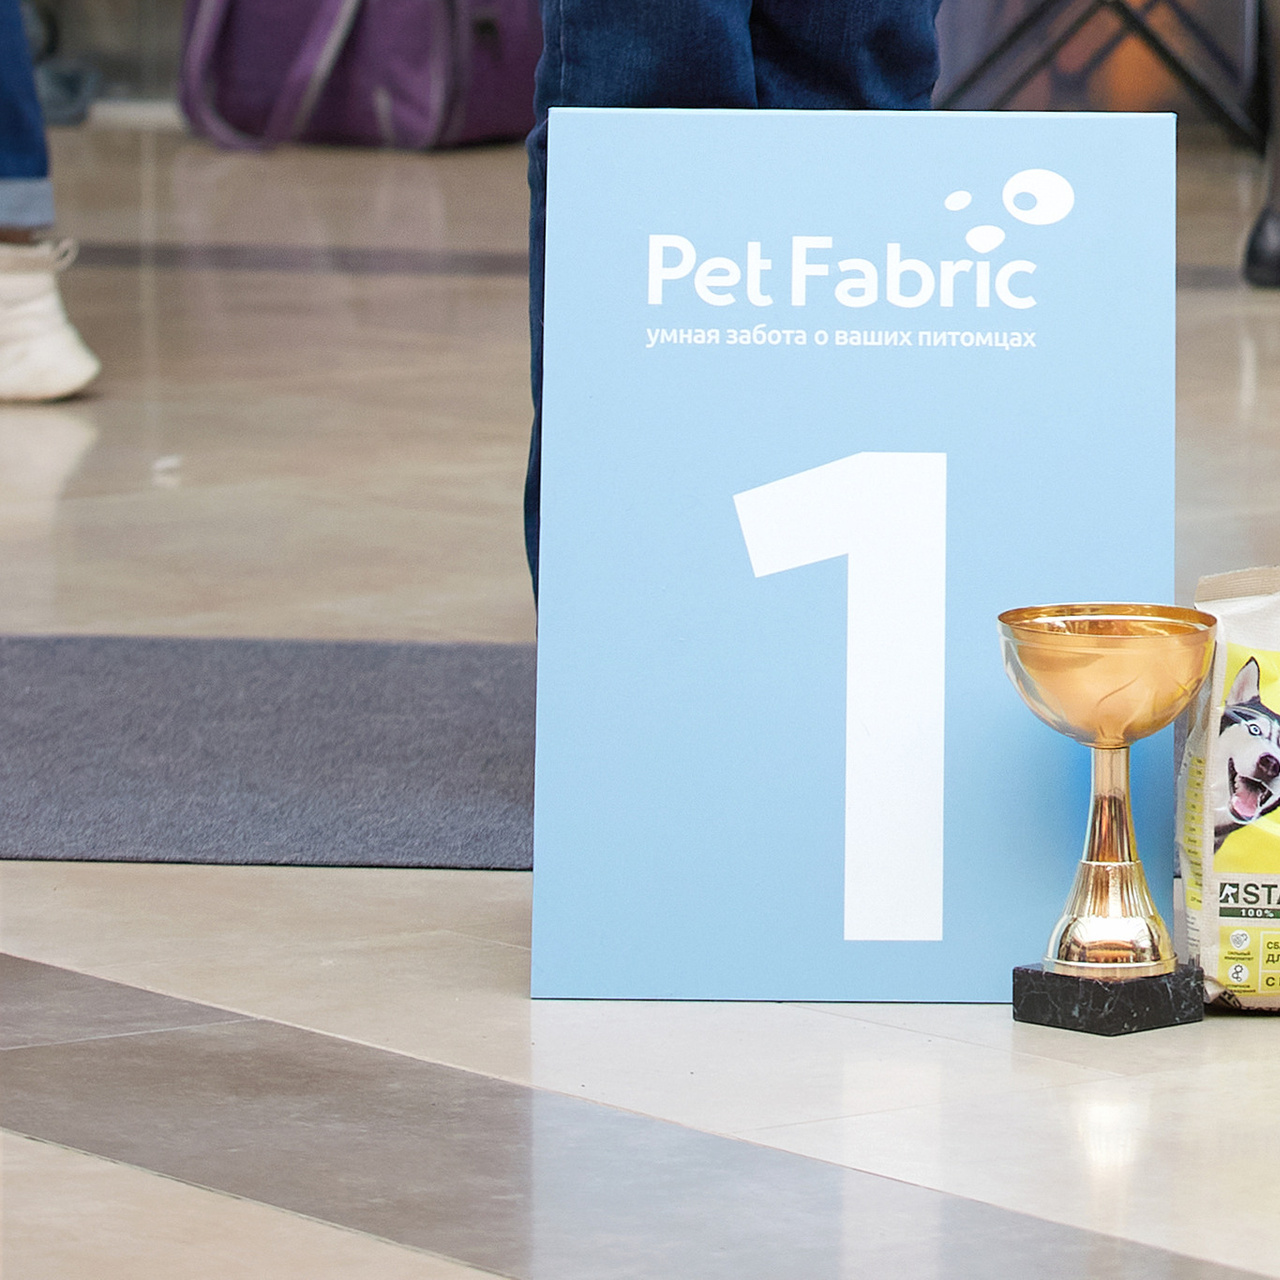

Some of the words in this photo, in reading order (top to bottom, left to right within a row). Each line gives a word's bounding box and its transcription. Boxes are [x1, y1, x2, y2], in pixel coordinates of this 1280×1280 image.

[647, 234, 774, 307] Pet
[791, 235, 1038, 310] Fabric
[645, 328, 720, 348] умная
[726, 324, 808, 346] забота
[814, 330, 830, 346] о
[835, 330, 912, 346] ваших
[918, 330, 1037, 351] питомцах
[732, 450, 948, 942] 1
[1240, 908, 1275, 918] 100%
[1266, 976, 1275, 987] С
